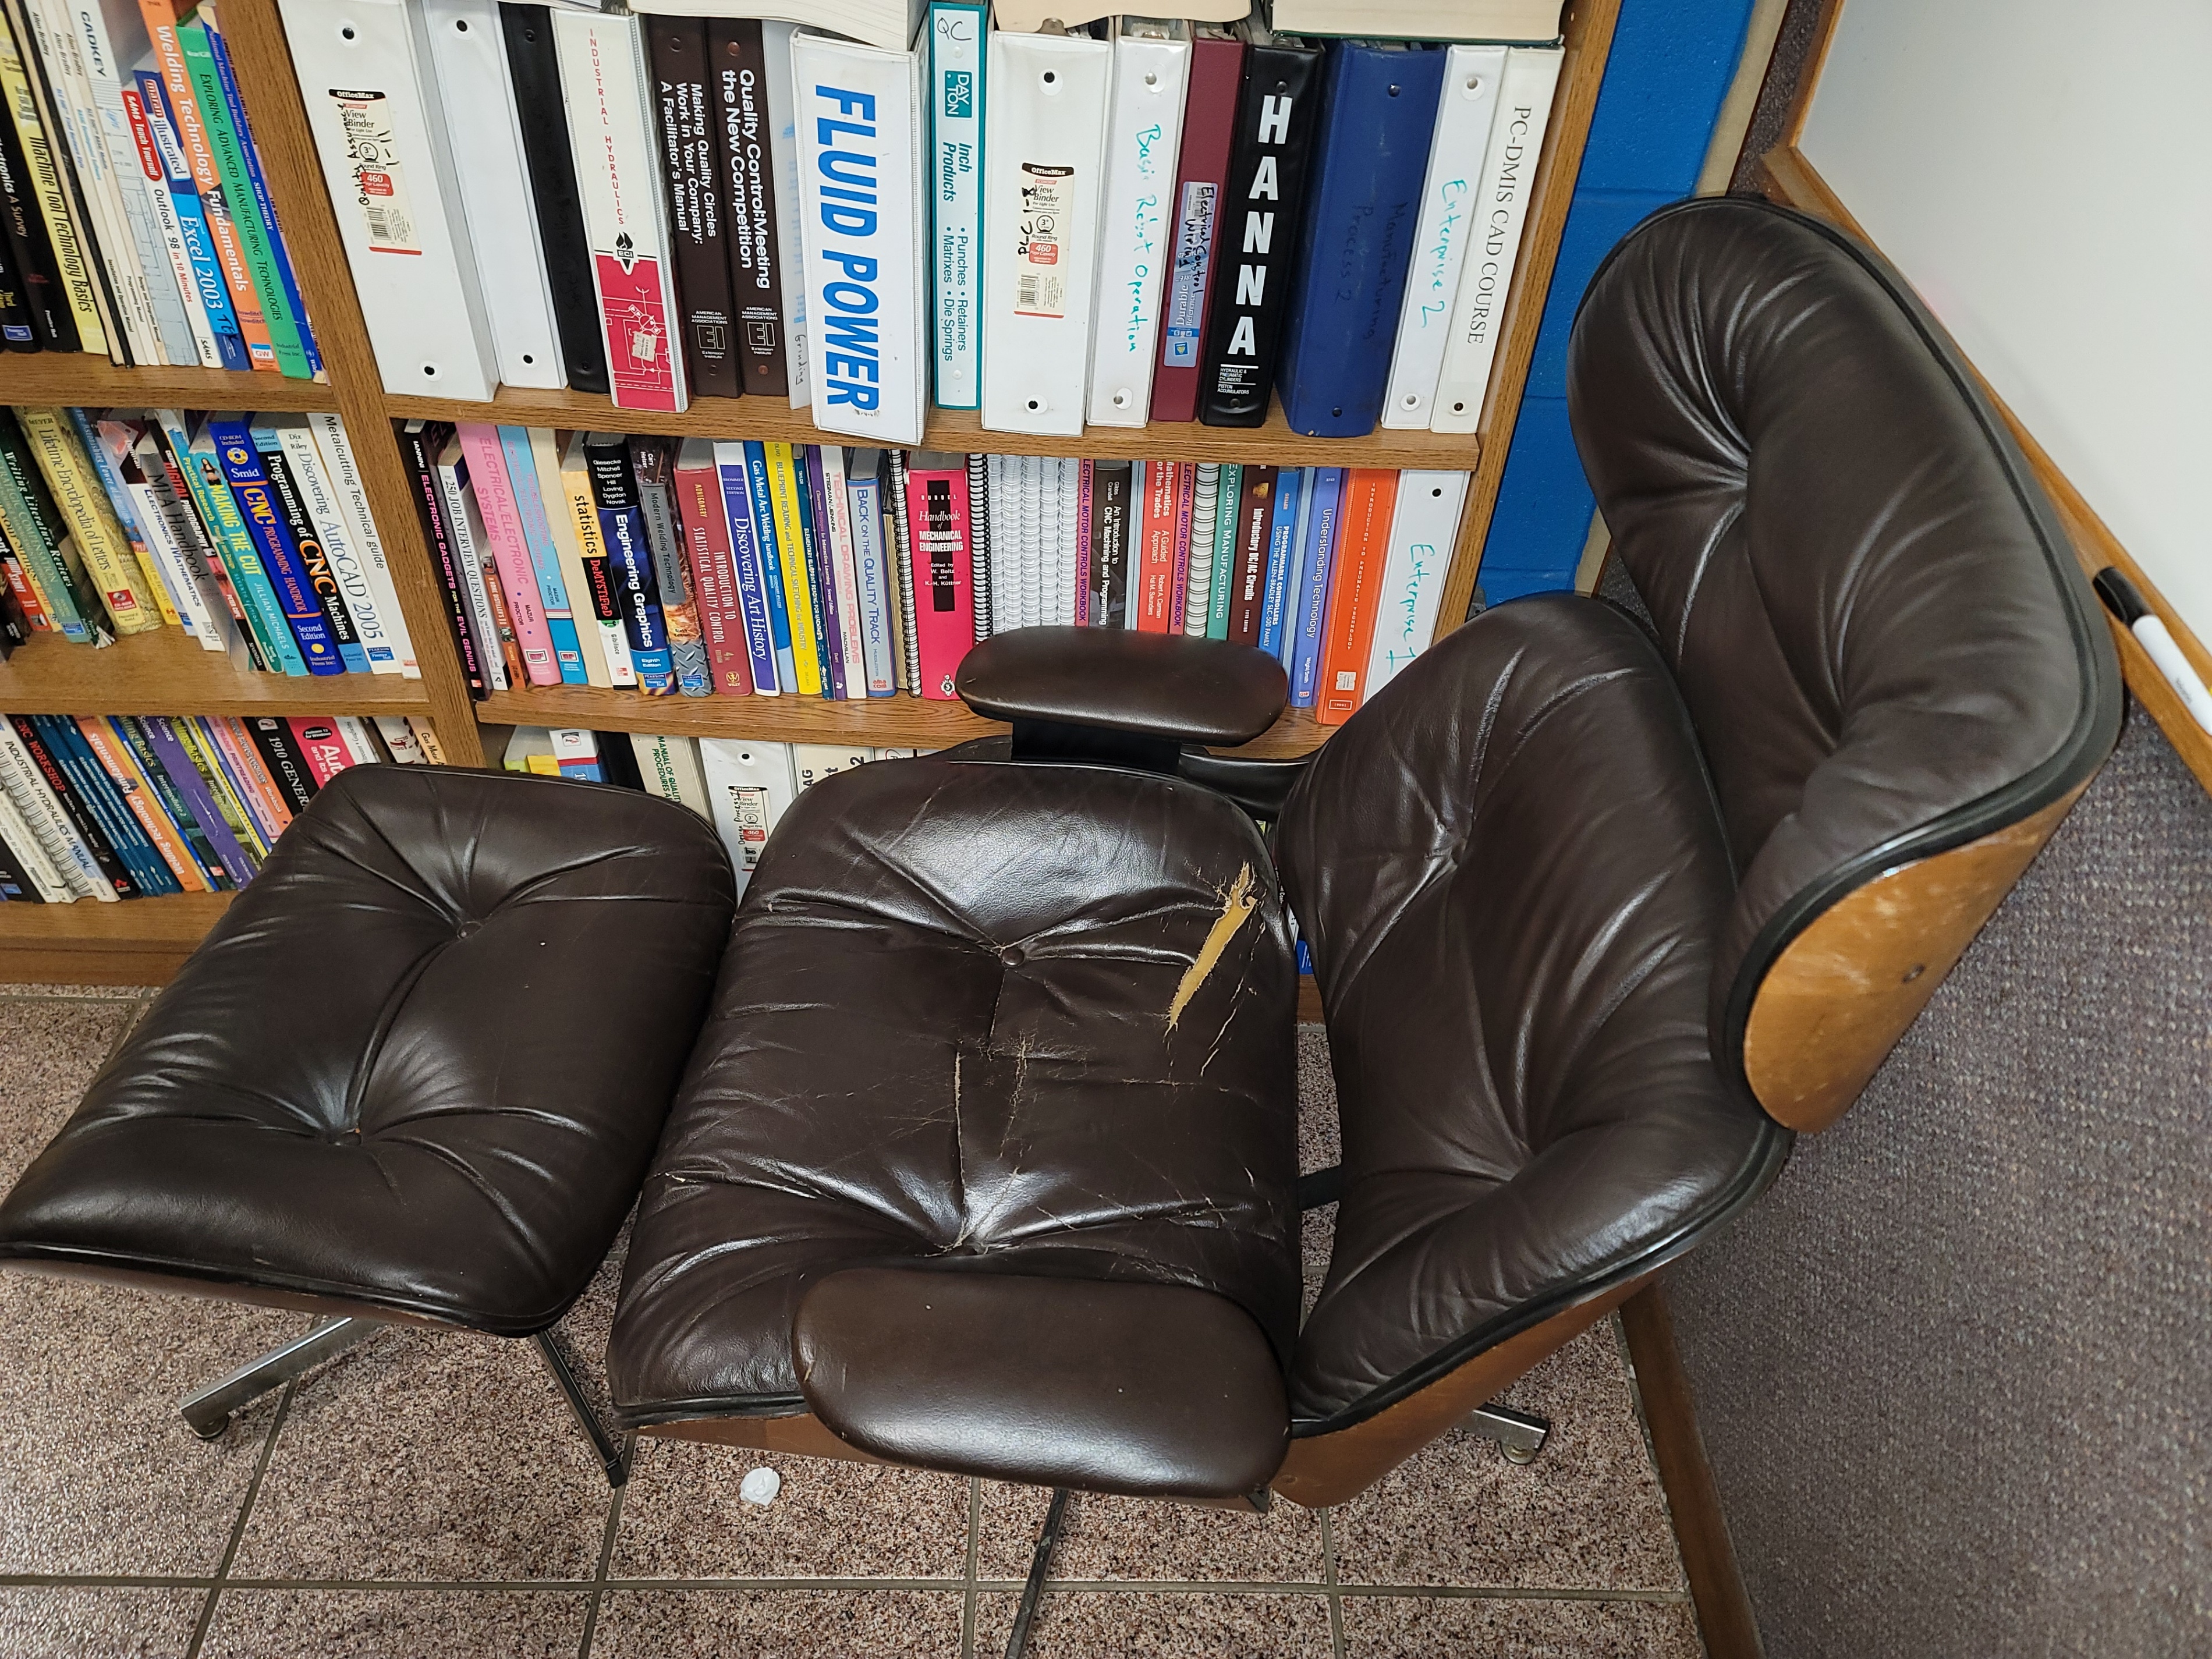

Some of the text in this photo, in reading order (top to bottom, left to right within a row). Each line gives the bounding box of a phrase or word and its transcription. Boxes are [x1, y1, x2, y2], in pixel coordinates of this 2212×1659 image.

[81, 10, 107, 77] CADKEY
[937, 17, 972, 41] QC
[127, 95, 159, 177] SAMS Teach Yourself
[154, 120, 187, 175] illustrated
[337, 91, 374, 99] OfficeMax
[590, 29, 625, 224] INDUSTRIAL HYDRAULICS
[740, 69, 758, 141] Quality
[156, 26, 249, 292] Welding Technology Fundamentals
[200, 73, 223, 123] EXPLORING
[216, 129, 239, 178] ADVANCED
[233, 182, 264, 256] MANUFACTURING
[257, 260, 283, 321] TECHNOLOGIES
[367, 175, 383, 183] 460
[661, 81, 690, 232] A Facilitator's Manual
[676, 82, 704, 245] Work in Your Company:
[691, 83, 716, 237] Making Quality Circles
[722, 70, 753, 268] the New Competition
[942, 142, 956, 201] Products
[959, 143, 973, 173] Inch
[1031, 167, 1066, 175] OfficeMax
[1033, 193, 1059, 202] Binder
[1036, 185, 1054, 193] View
[52, 216, 82, 278] Technology
[70, 279, 93, 312] Basics
[154, 189, 193, 303] Outlook 98 in 10 Minutes
[180, 215, 223, 309] Excel 2003
[815, 84, 880, 411] FLUID POWER
[1227, 95, 1293, 356] HANNA
[1467, 106, 1532, 345] PC-DMIS CAD COURSE
[942, 235, 955, 361] Matrixes Die Springs
[958, 236, 969, 352] Punches Retainers
[1421, 300, 1445, 328] 2
[4, 451, 74, 589] Writing Literature Reviews
[148, 473, 207, 582] MLA Handbook
[231, 468, 260, 478] Smid
[323, 416, 384, 569] Metalcutting Technical guide
[574, 495, 598, 555] statistics
[752, 460, 775, 571] Gas Metal Arc Welding handbook
[918, 511, 960, 522] Handbook
[208, 484, 263, 576] MAKING THE CUT
[243, 488, 308, 614] CNC PROGRAMMING HANDBOOK
[267, 455, 350, 640] Programming of CNC Machines
[297, 452, 384, 640] Discovering AutoCAD 2005
[421, 474, 477, 672] ELECTRONIC GADGETS EVIL GENIUS
[444, 481, 488, 619] 250 JOB INTERVIEW QUESTIONS
[615, 513, 654, 648] Engineering Graphics
[650, 492, 678, 594] Modern Welding Technology
[856, 488, 881, 645] BACK ON THE QUALITY TRACK
[919, 530, 963, 541] MECHANICAL
[919, 541, 963, 552] ENGINEERING
[1098, 506, 1112, 625] CNC Machining and Programming
[1306, 509, 1332, 639] Understanding Technology
[254, 583, 290, 650] JILLIAN MICHAELS
[692, 526, 726, 644] STATISTICAL QUALITY CONTROL
[712, 551, 737, 621] INTRODUCTION TO
[733, 516, 768, 661] Discovering Art History
[268, 736, 288, 758] 1910
[421, 732, 440, 761] Gas Metal
[651, 748, 670, 793] PROCEDURES
[657, 736, 674, 778] MANUAL OF
[5, 740, 40, 788] INDUSTRIAL
[36, 788, 71, 836] HYDRAULICS
[65, 835, 91, 870] MANUAL
